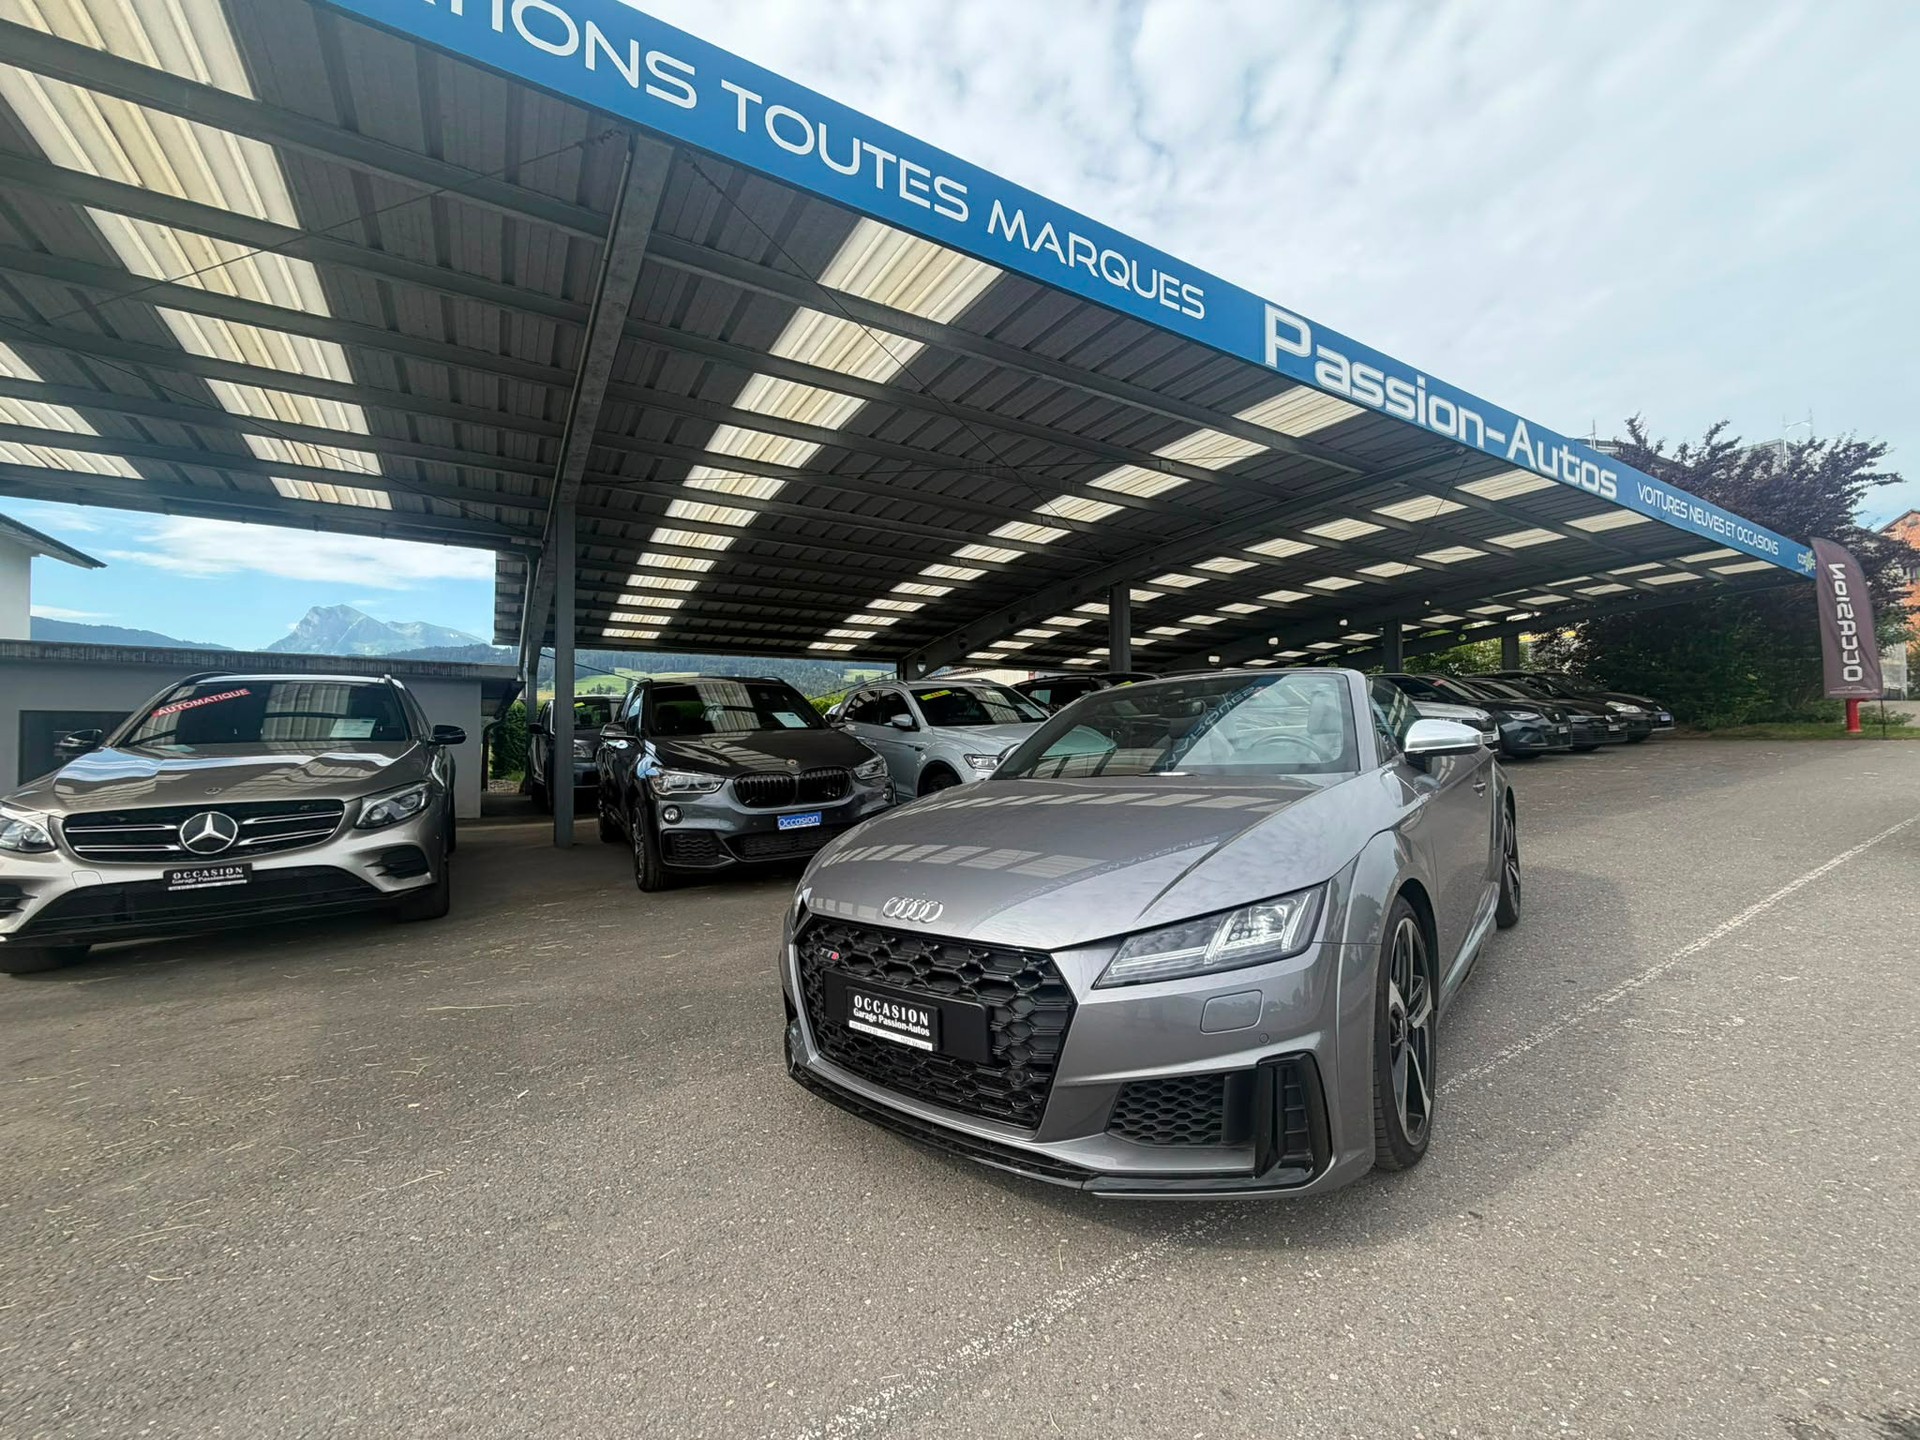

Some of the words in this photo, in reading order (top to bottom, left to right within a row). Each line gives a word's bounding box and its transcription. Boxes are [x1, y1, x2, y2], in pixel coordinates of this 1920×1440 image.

[424, 0, 698, 109] IONS
[721, 79, 970, 222] TOUTES
[987, 199, 1205, 320] MARQUES
[1264, 303, 1617, 500] Passion-Autos
[1637, 482, 1688, 519] VOITURES
[1688, 504, 1725, 534] NEUVES
[1725, 521, 1736, 538] ET
[1736, 526, 1779, 556] OCCASIONS
[158, 688, 251, 716] AUTOMATIQUE
[172, 866, 243, 879] OCCASION
[853, 1007, 877, 1022] Garage
[878, 1014, 930, 1037] Passion-Autos
[854, 995, 928, 1026] OCCASION
